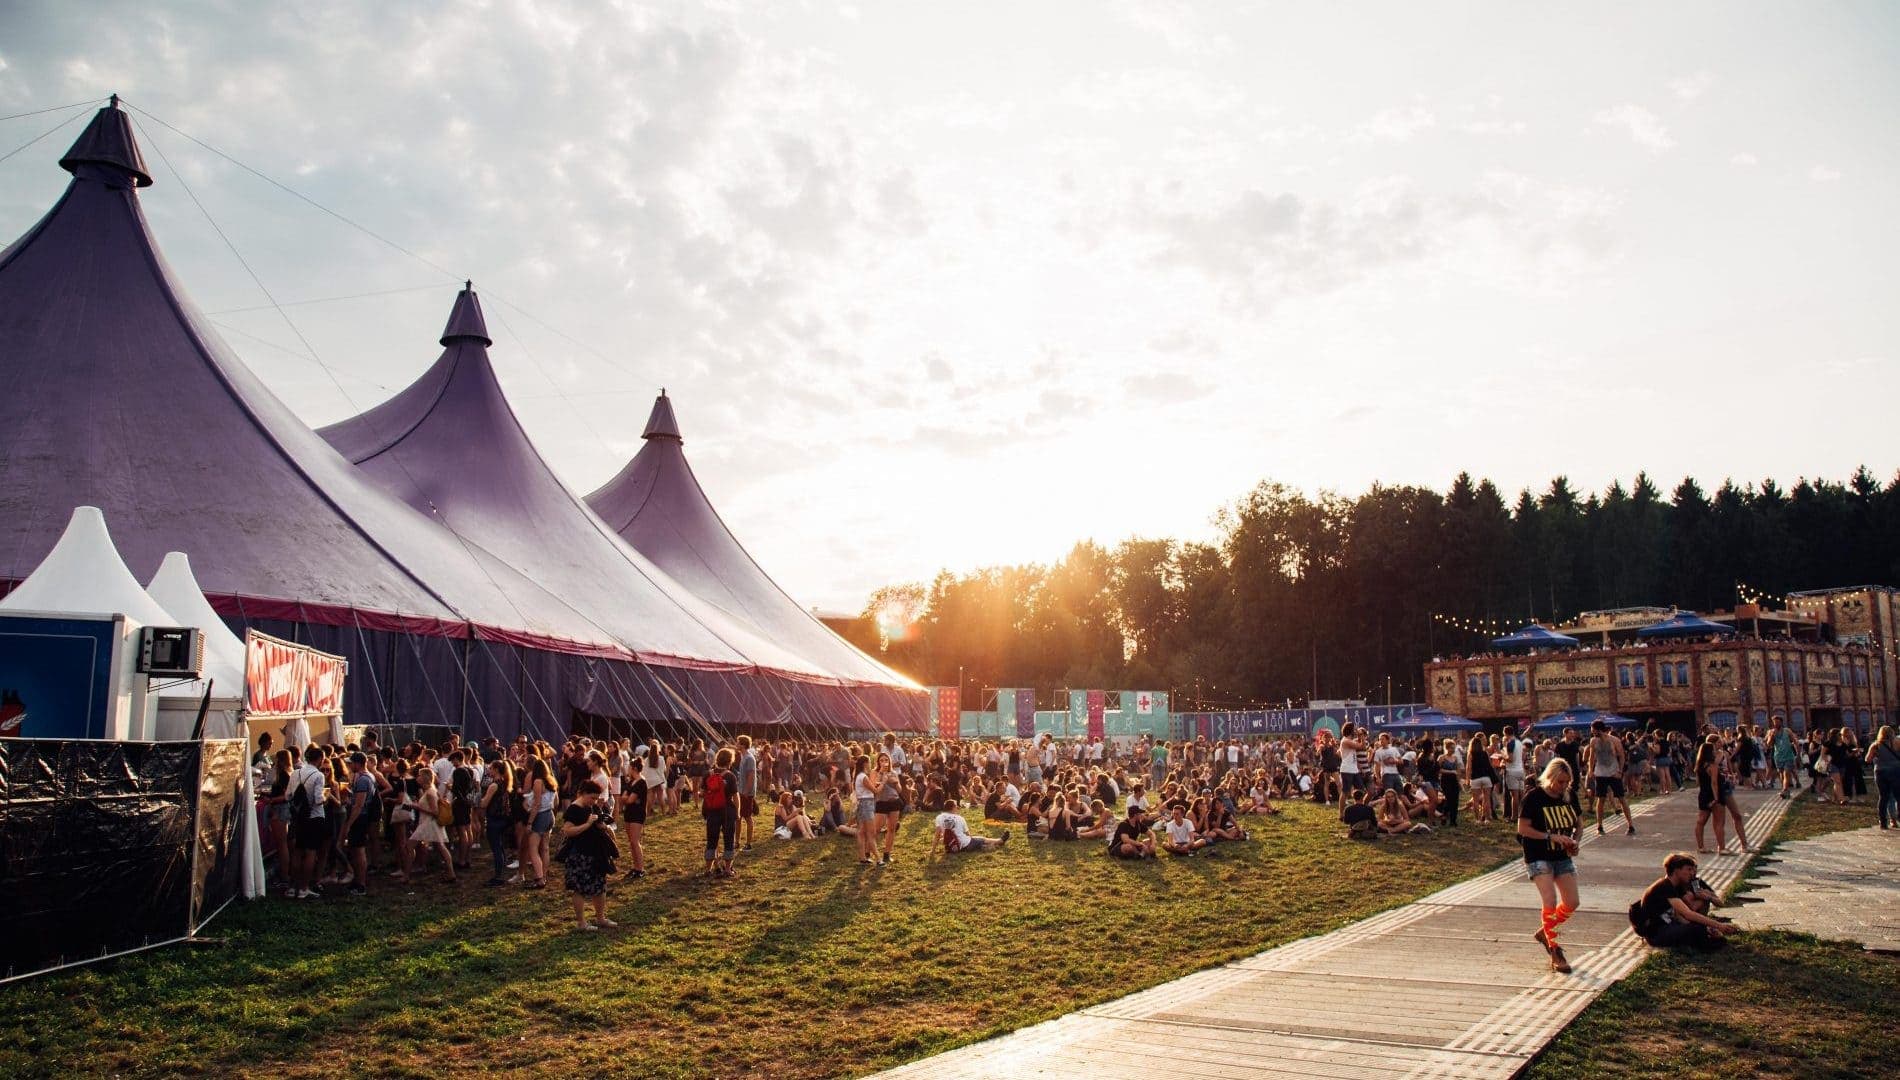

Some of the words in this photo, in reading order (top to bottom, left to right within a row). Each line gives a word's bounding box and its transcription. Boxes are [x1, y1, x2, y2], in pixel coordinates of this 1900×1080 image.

[1537, 675, 1605, 686] FELDSCHLÖSSCHEN
[1252, 719, 1263, 728] WC
[1290, 717, 1301, 726] WC
[1374, 714, 1385, 724] WC
[1543, 805, 1577, 829] NIRV
